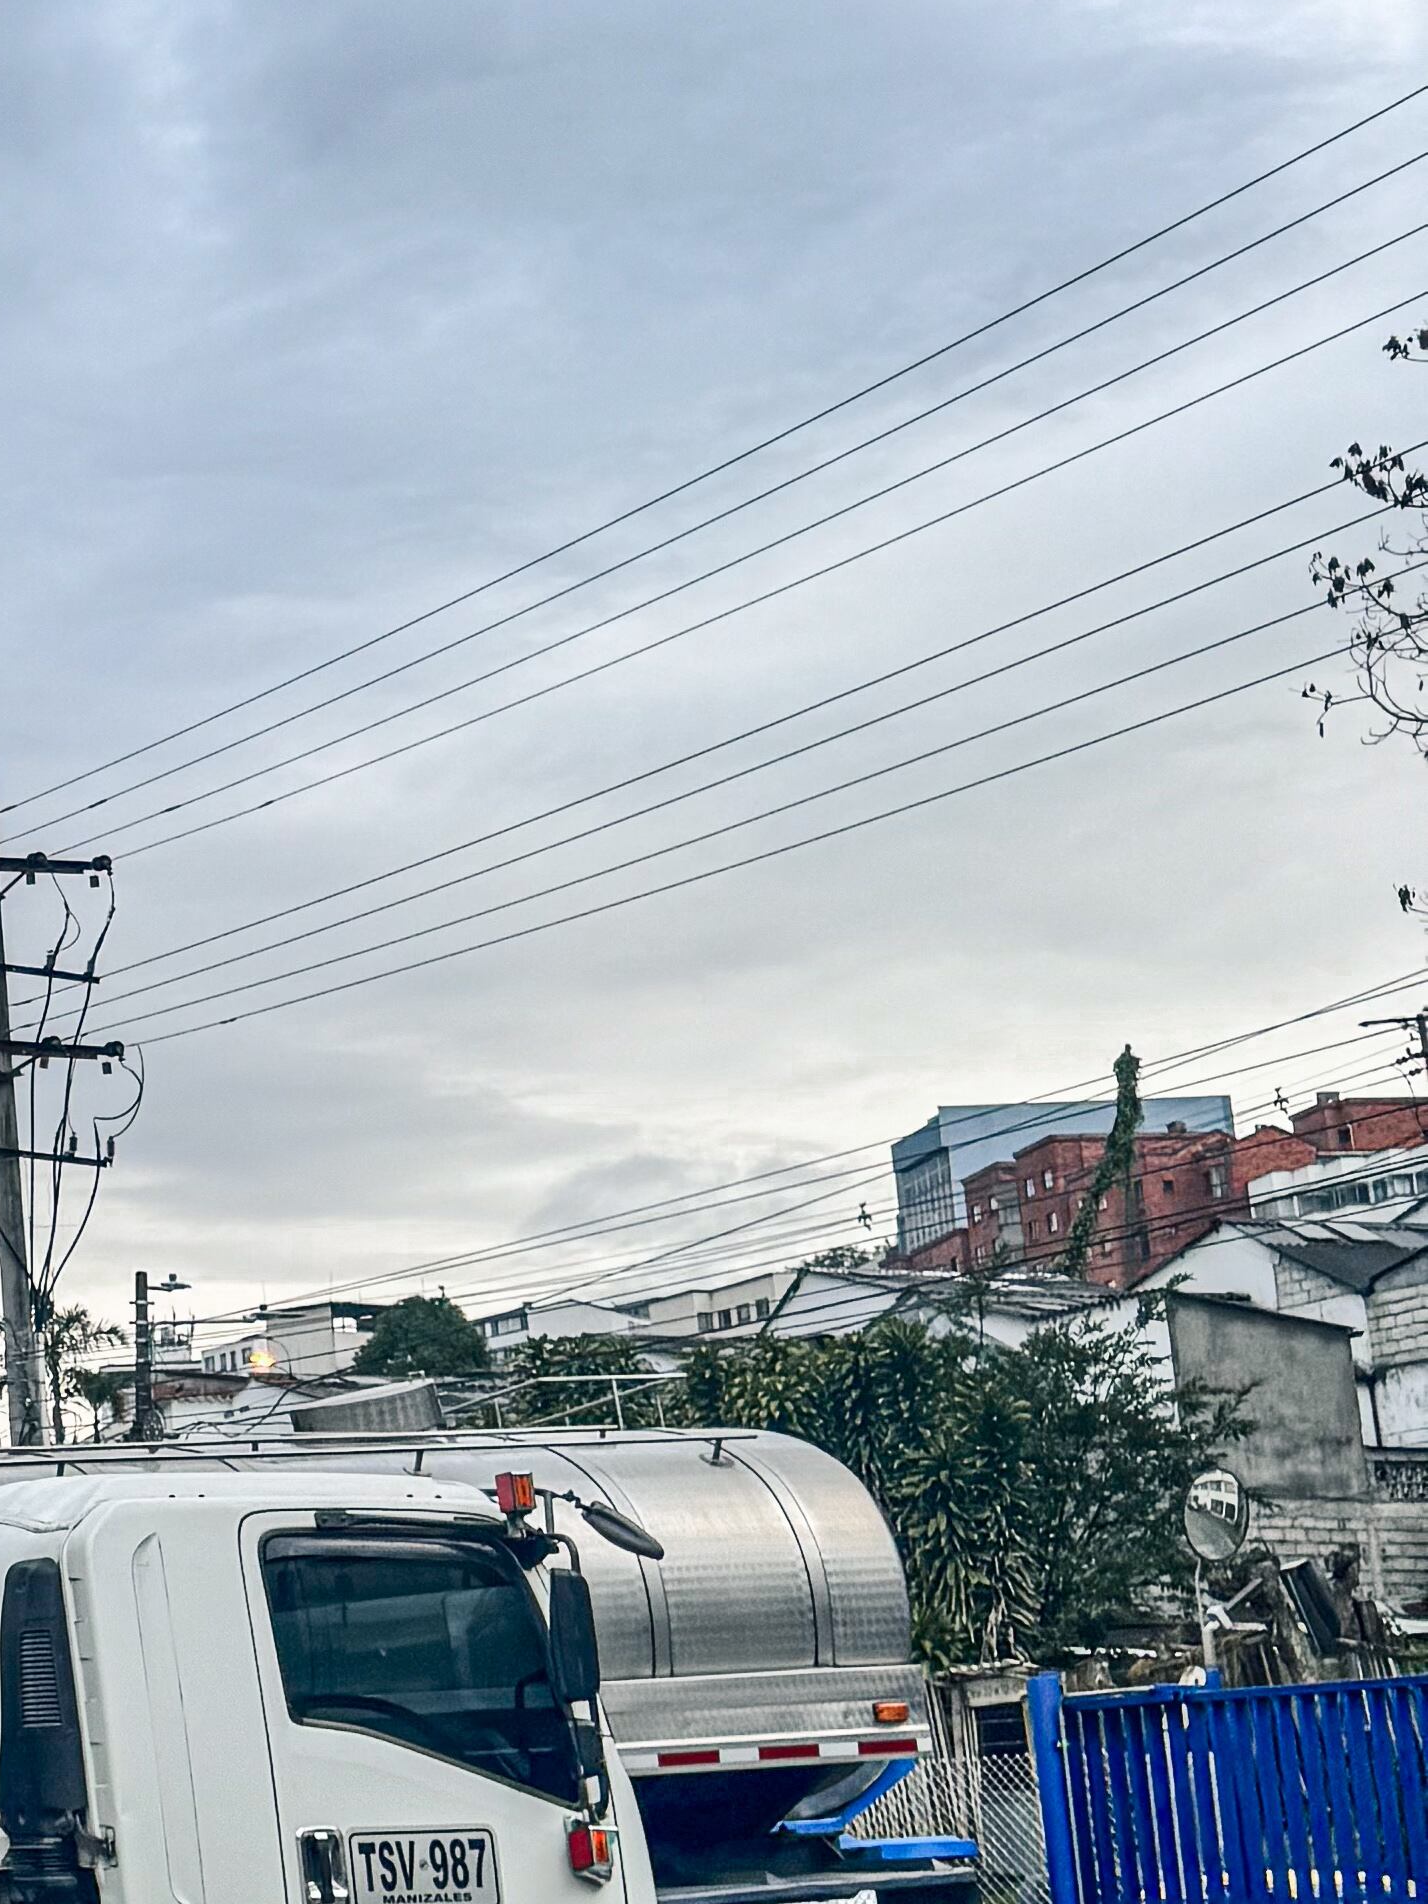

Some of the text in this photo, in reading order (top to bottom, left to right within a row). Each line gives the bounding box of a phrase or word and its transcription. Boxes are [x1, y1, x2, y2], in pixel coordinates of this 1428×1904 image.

[357, 1838, 487, 1893] TSV 987
[382, 1891, 473, 1904] MANIZALES
